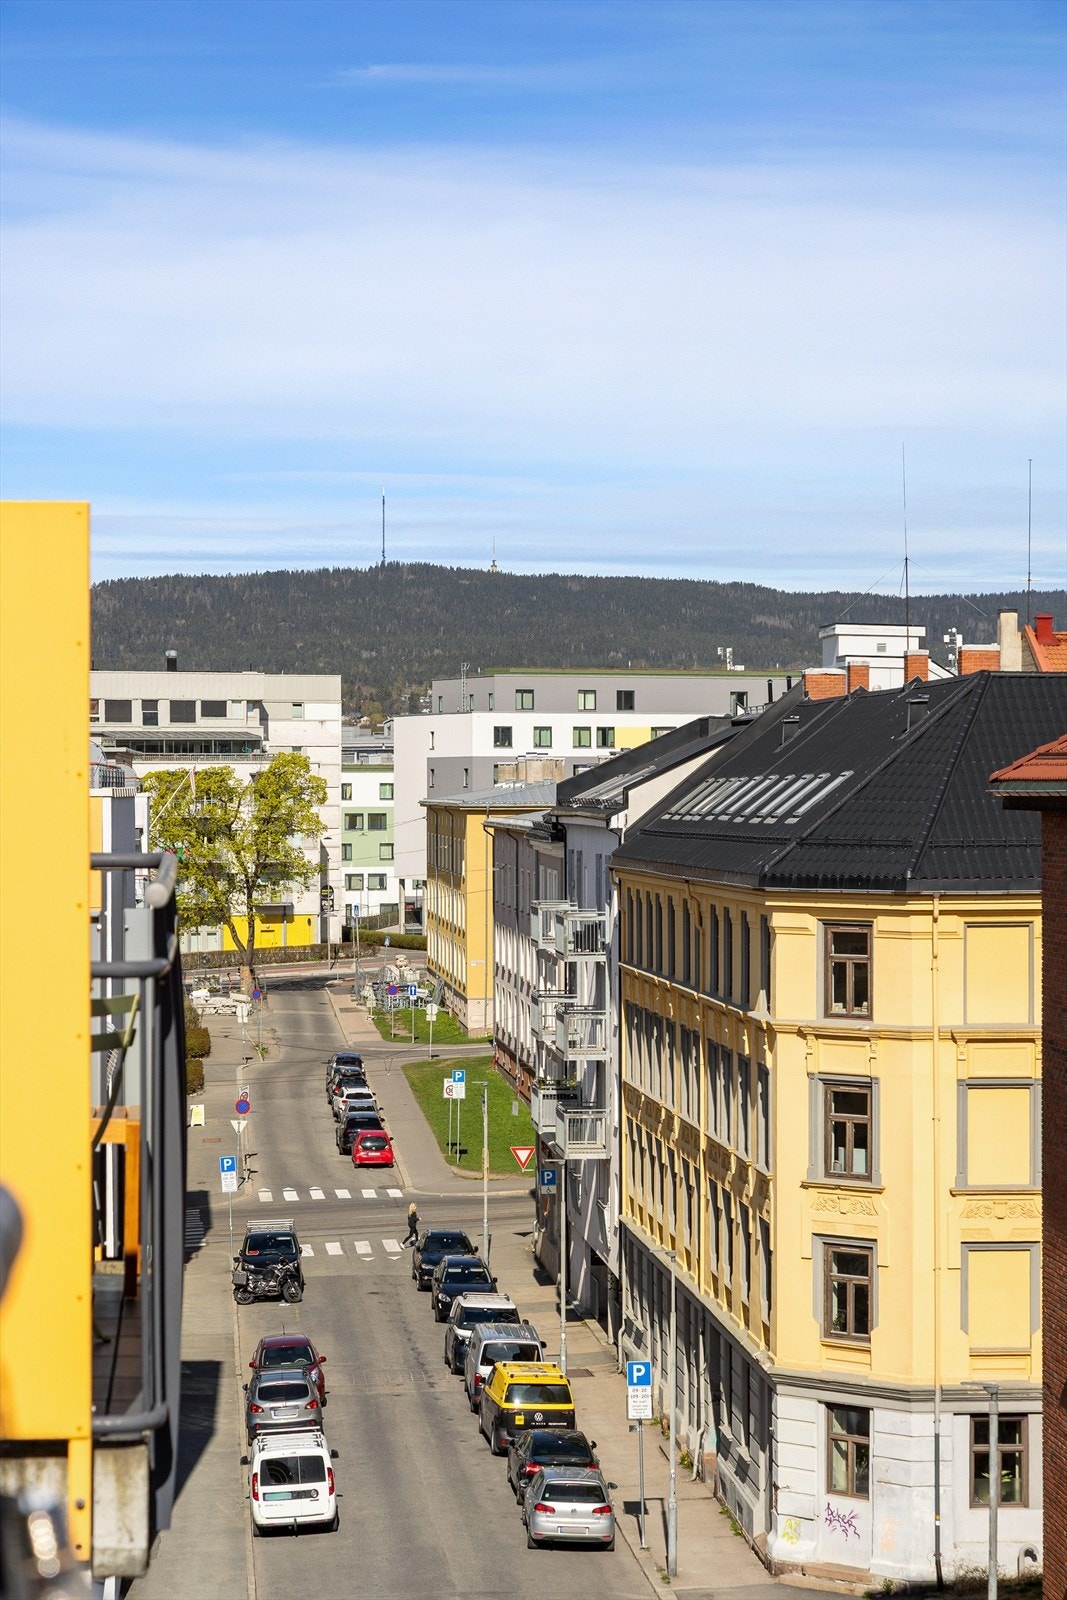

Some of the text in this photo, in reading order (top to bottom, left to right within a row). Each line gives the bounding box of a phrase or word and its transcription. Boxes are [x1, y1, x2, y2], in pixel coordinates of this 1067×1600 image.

[456, 1072, 462, 1081] P
[223, 1158, 232, 1171] P
[544, 1171, 553, 1184] P
[632, 1364, 646, 1384] P
